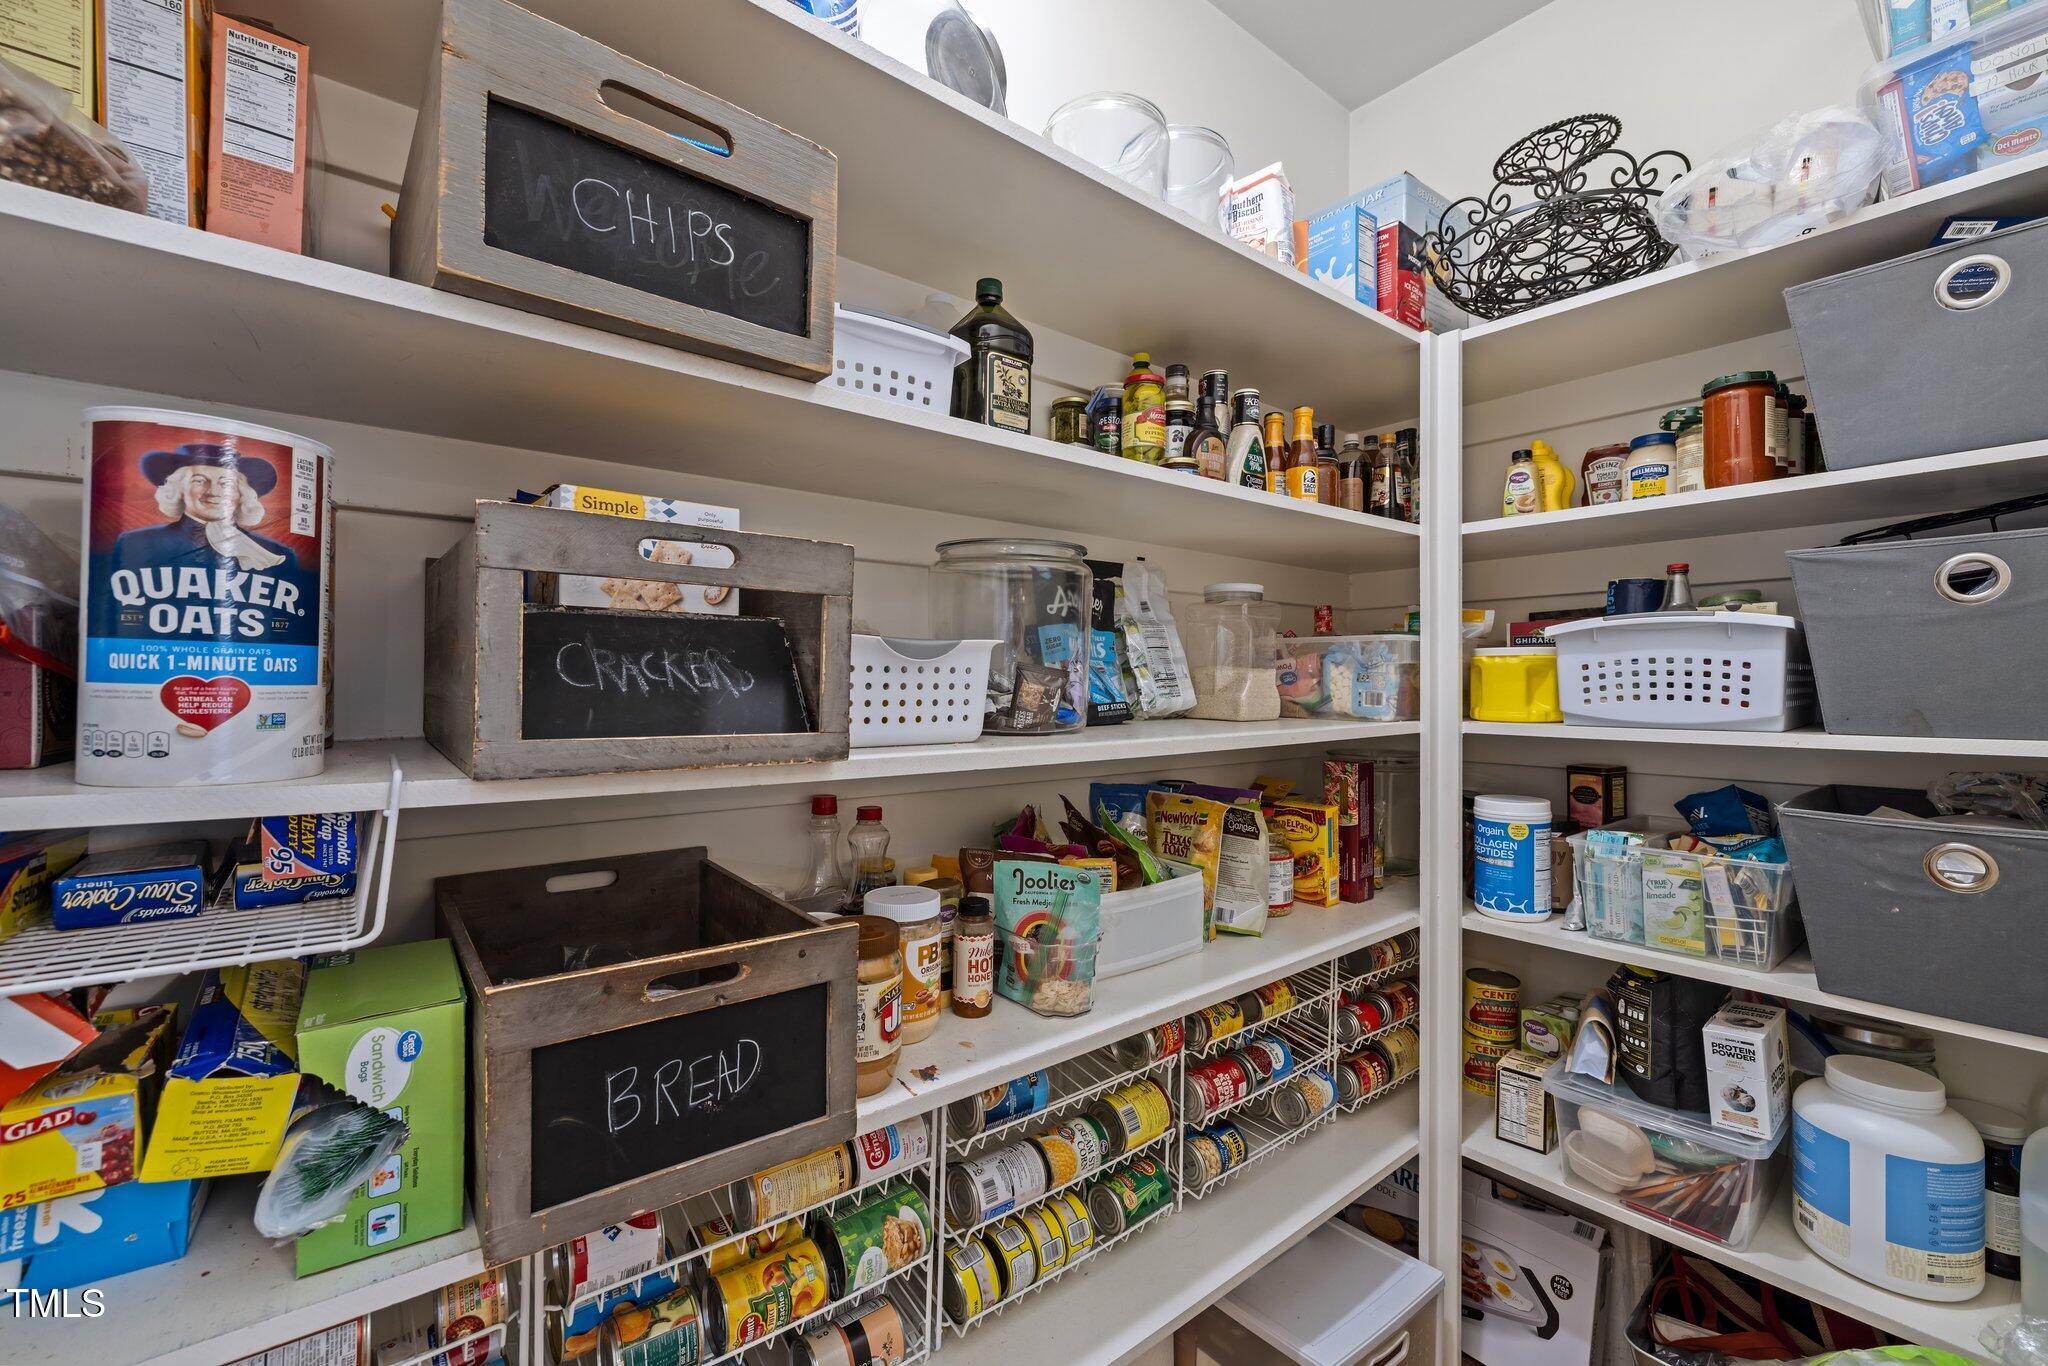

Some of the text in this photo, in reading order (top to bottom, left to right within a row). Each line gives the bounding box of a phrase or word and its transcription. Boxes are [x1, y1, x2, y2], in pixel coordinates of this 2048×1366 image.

[228, 29, 298, 60] Nutrition Facts
[228, 55, 297, 84] Calories 20
[1997, 132, 2038, 152] Del Monte
[1231, 193, 1264, 212] outhern
[1360, 188, 1385, 209] JAR
[571, 176, 736, 267] CHIPS
[1595, 462, 1619, 471] HEINZ
[1631, 465, 1667, 478] HELLMANN'S
[1640, 481, 1658, 490] REAL
[581, 495, 639, 515] Simple
[111, 567, 300, 616] QUAKER
[149, 603, 265, 638] OATS
[1045, 635, 1062, 644] ZERO
[1514, 636, 1556, 646] GHIRARD
[171, 646, 210, 654] WHOLE
[213, 646, 245, 656] GRAIN
[109, 652, 298, 672] QUICK 1-MINUTE OATS
[556, 642, 755, 699] CRACKERS
[1097, 703, 1126, 712] BEEF STICKS
[288, 815, 299, 851] DUTY
[301, 813, 318, 861] HEAVY
[1228, 821, 1259, 835] Garden
[1477, 823, 1505, 838] Orgain
[338, 812, 353, 867] Reynolds
[1162, 830, 1192, 848] TEXAS
[268, 846, 296, 876] 95
[1161, 844, 1191, 860] TOAST
[76, 879, 114, 889] Liners
[1012, 867, 1077, 897] Joolies
[1650, 878, 1669, 887] TRUE
[62, 886, 136, 911] Cooker
[136, 881, 198, 905] Slow
[1012, 897, 1031, 906] Fresh
[1646, 891, 1677, 900] limeade
[137, 903, 198, 920] Reynolds
[1659, 935, 1687, 946] original
[967, 957, 993, 974] HOT
[1481, 989, 1517, 1001] CENTO
[1490, 1004, 1517, 1015] MARZA
[1494, 1029, 1518, 1038] TOMA
[408, 1033, 417, 1057] Great
[1711, 1041, 1757, 1057] PROTEIN
[1711, 1049, 1757, 1063] POWDER
[357, 1060, 369, 1084] Bags
[371, 1034, 386, 1103] Sandwich
[606, 1038, 762, 1134] BREAD
[4, 1108, 75, 1141] GLAD
[1073, 1122, 1096, 1153] CREAM
[867, 1132, 888, 1168] Carna
[1076, 1140, 1091, 1172] CORN
[2, 1189, 27, 1208] 25
[776, 1289, 788, 1326] Peaches
